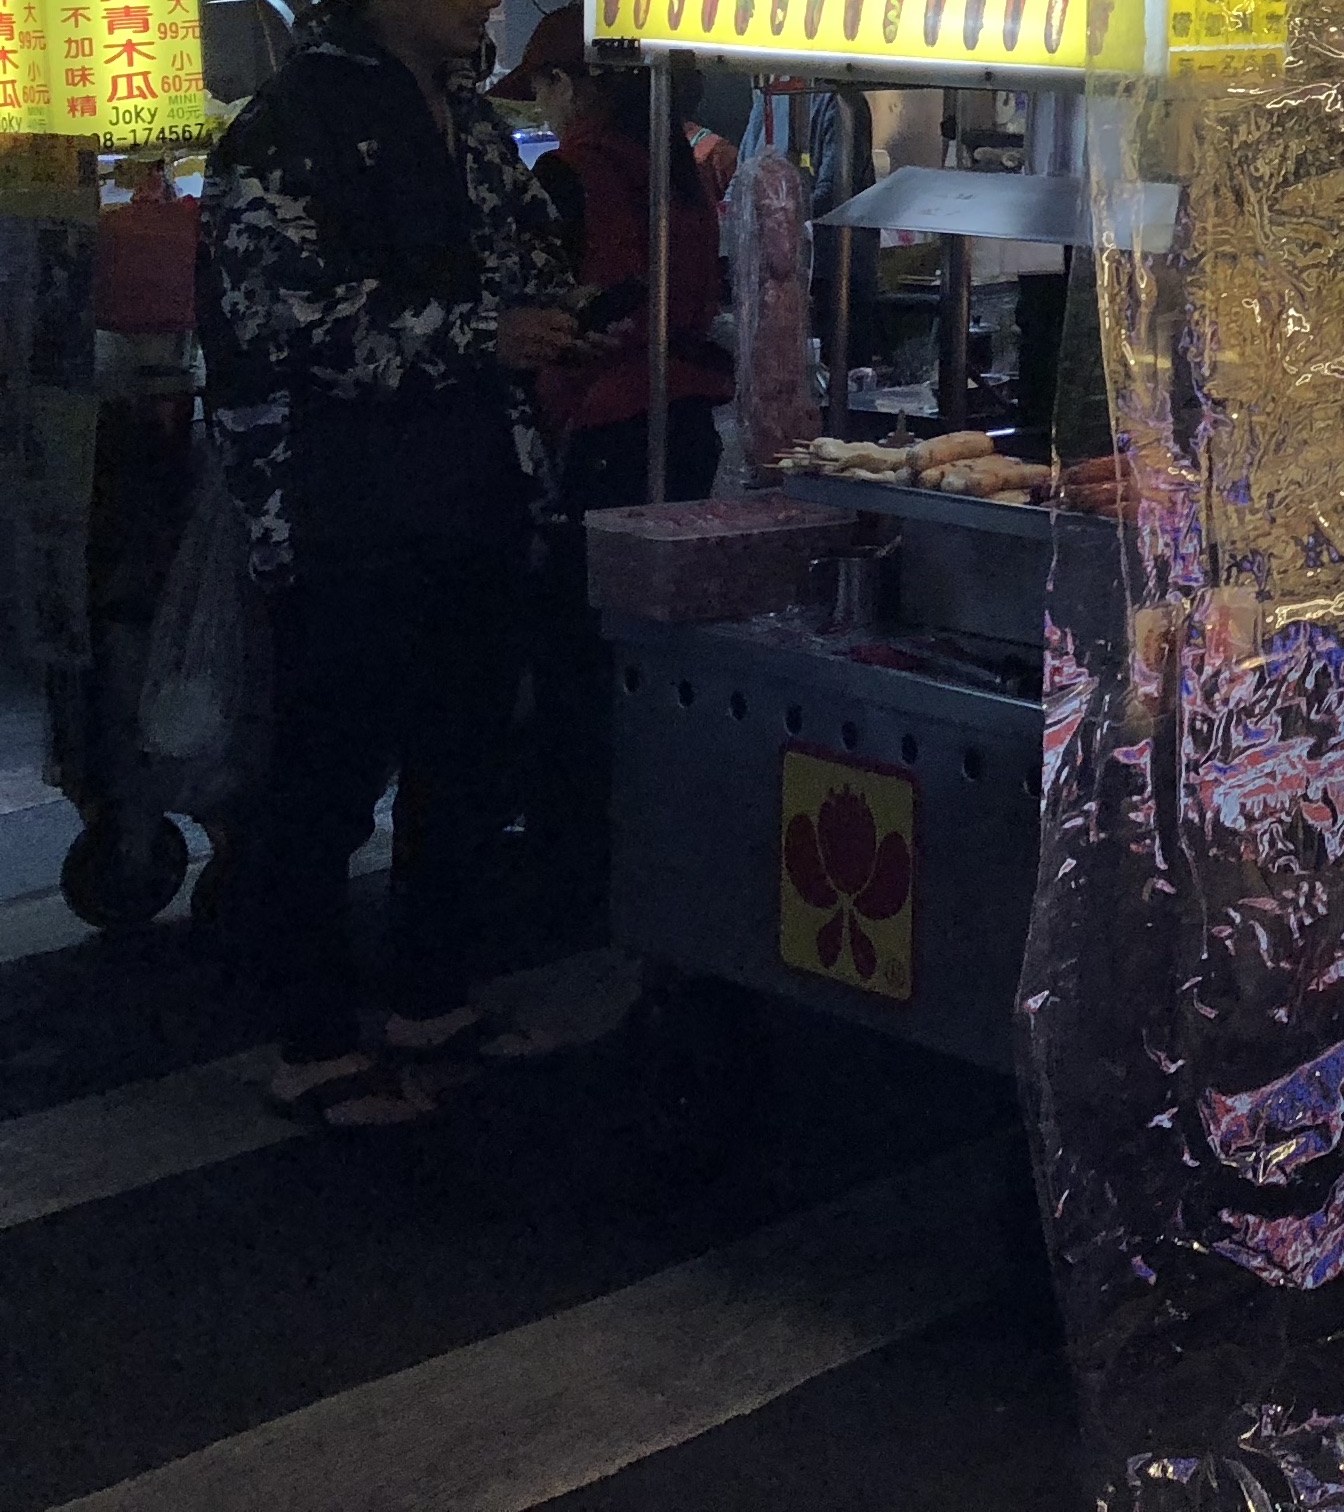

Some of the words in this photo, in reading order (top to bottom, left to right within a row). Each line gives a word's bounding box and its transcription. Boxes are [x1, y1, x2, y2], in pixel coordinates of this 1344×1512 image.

[157, 19, 202, 41] 99元
[61, 6, 97, 118] 不加味精
[171, 50, 192, 71] 小
[161, 72, 204, 93] 60元
[168, 94, 197, 105] MINI
